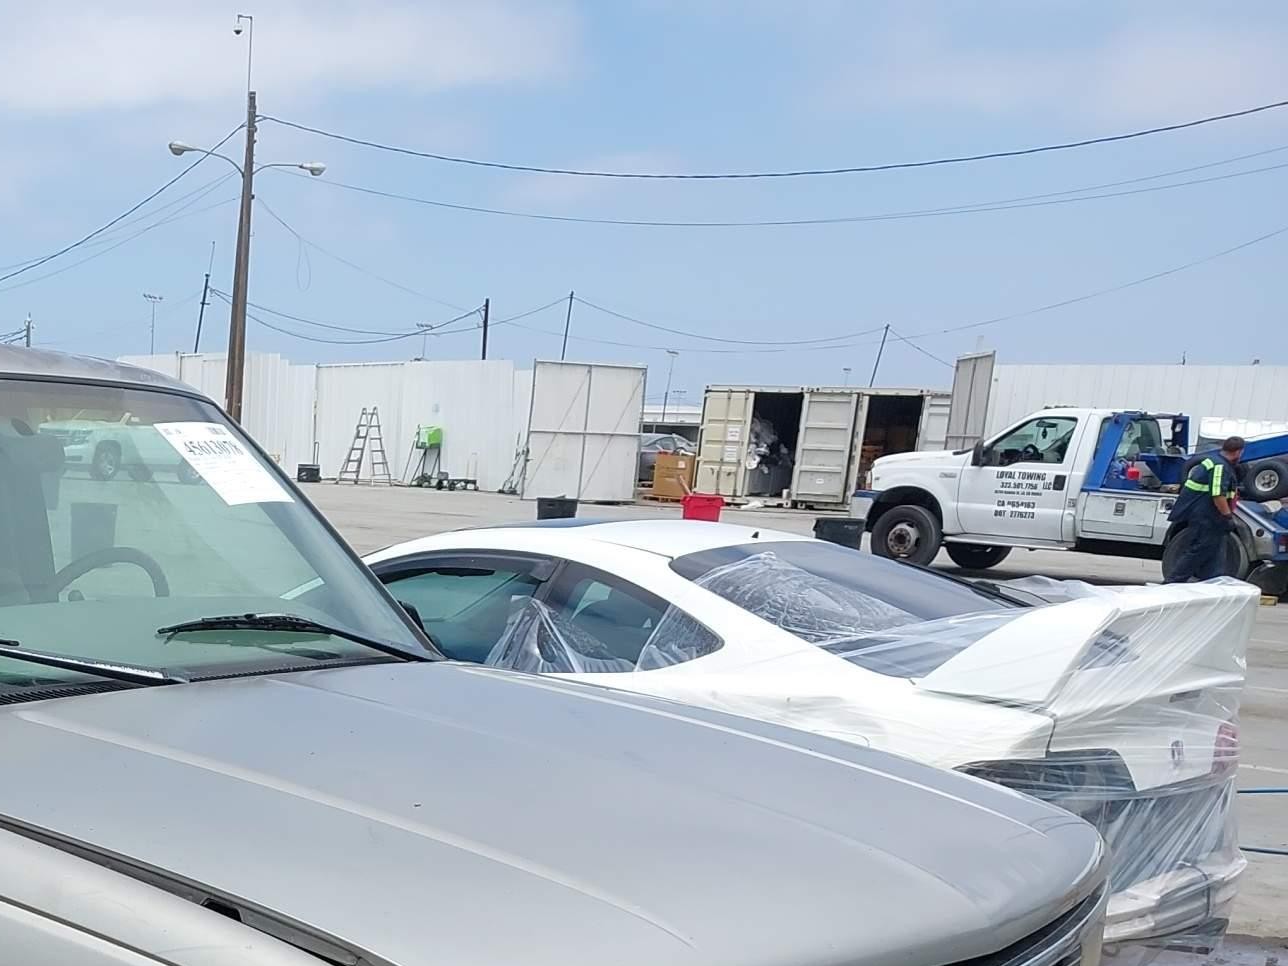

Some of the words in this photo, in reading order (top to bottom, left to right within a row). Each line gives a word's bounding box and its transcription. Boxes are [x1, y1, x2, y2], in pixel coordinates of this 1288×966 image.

[996, 470, 1016, 480] LOYAL
[1017, 471, 1047, 481] TOWING
[996, 499, 1005, 507] CA
